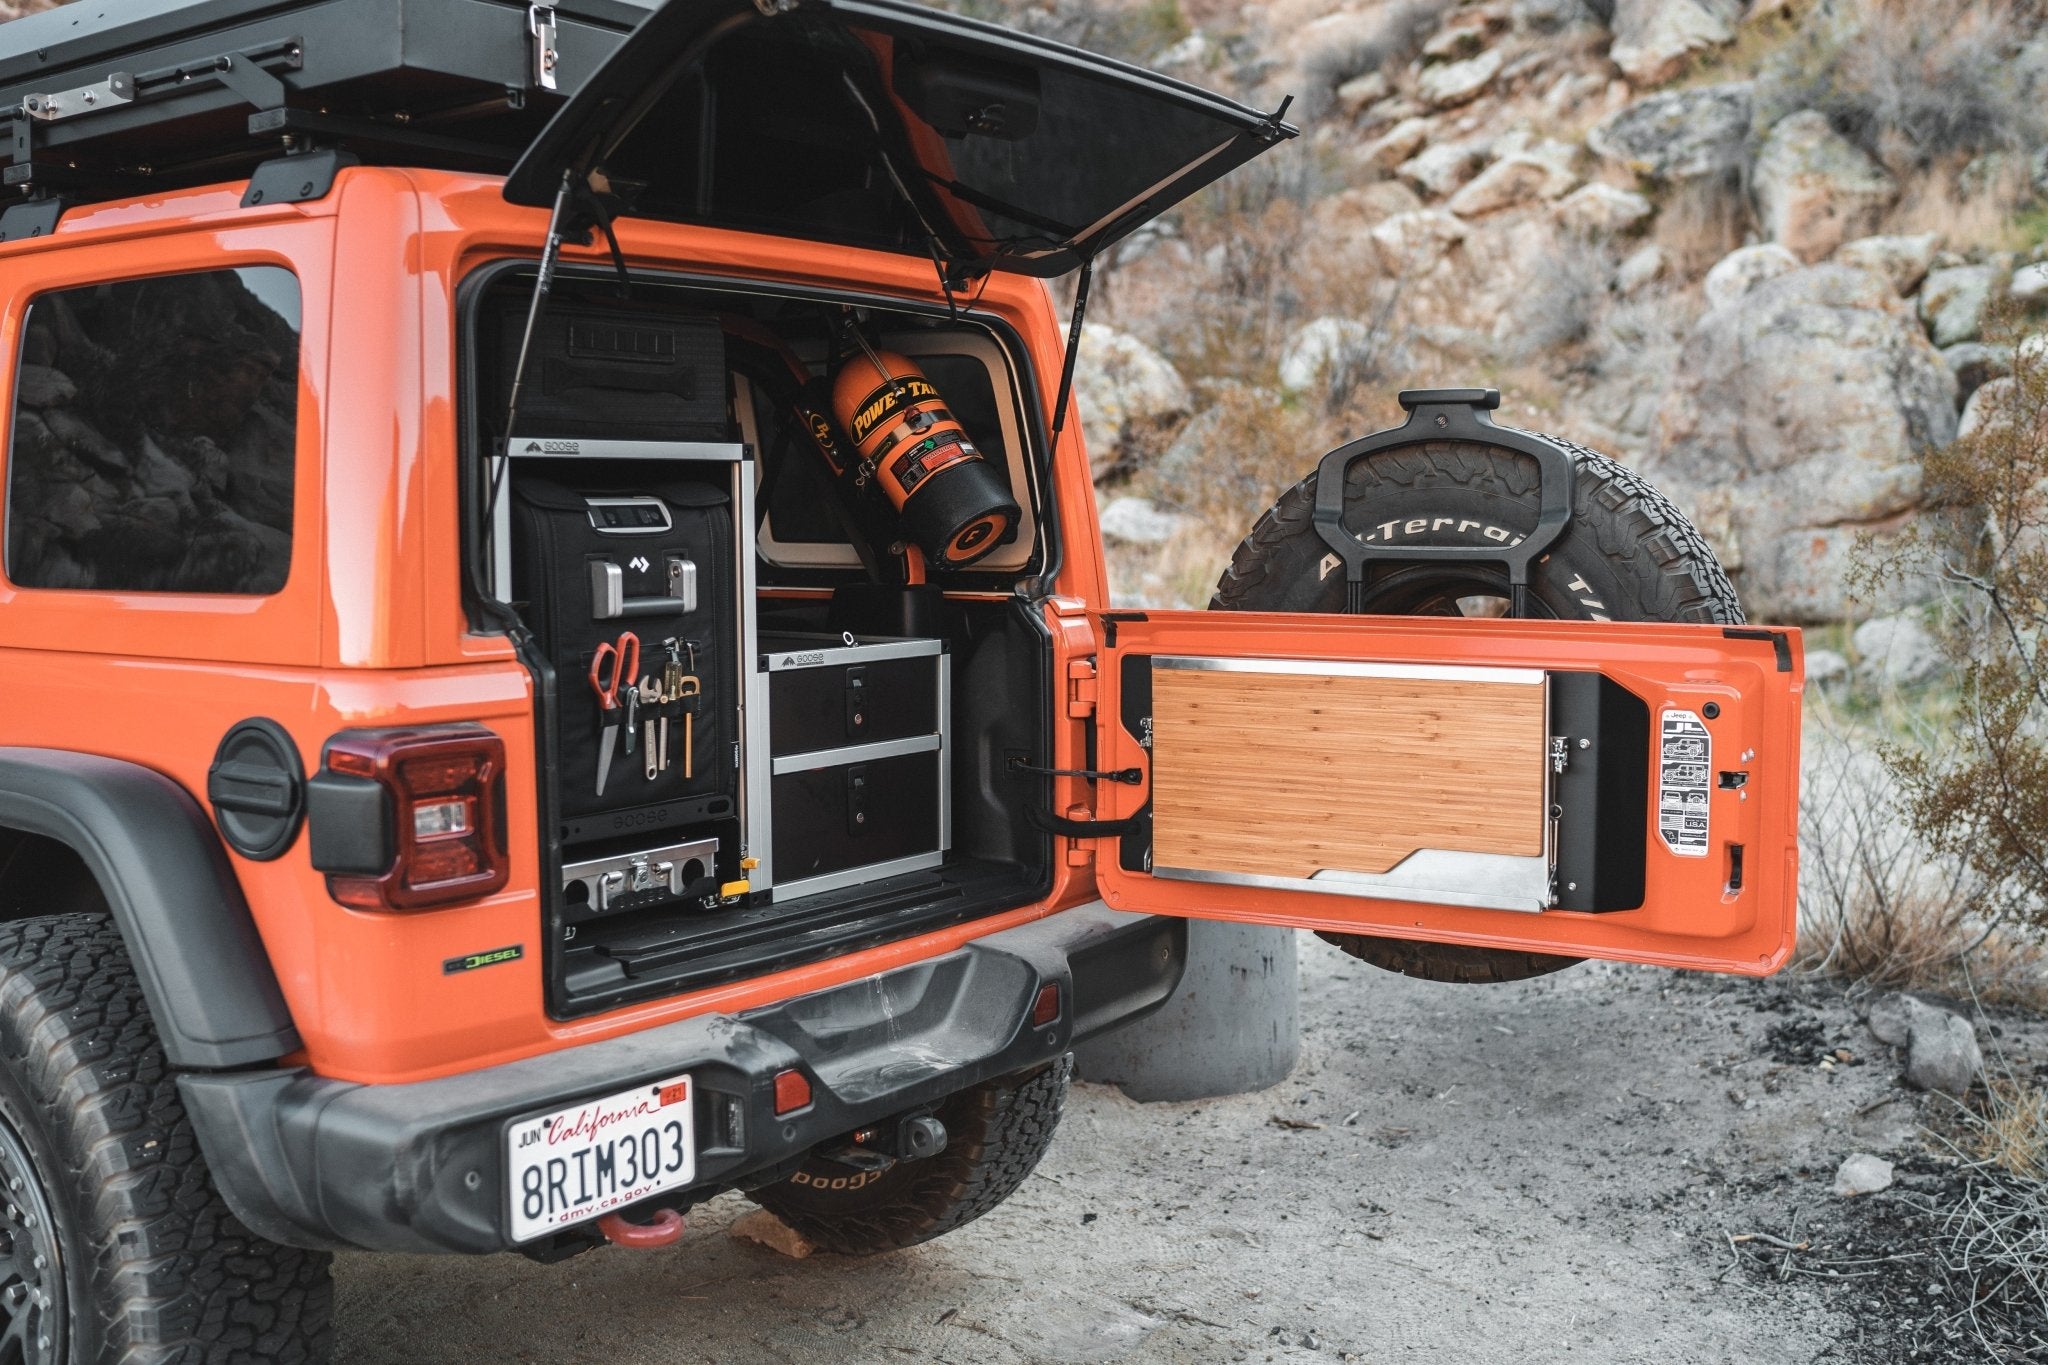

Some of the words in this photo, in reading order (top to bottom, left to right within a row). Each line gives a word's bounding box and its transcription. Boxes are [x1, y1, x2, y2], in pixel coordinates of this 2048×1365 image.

[518, 1128, 542, 1148] JUN
[547, 1101, 661, 1146] California
[522, 1120, 684, 1220] 8RIM303
[559, 1184, 653, 1223] dmv.ca.gov
